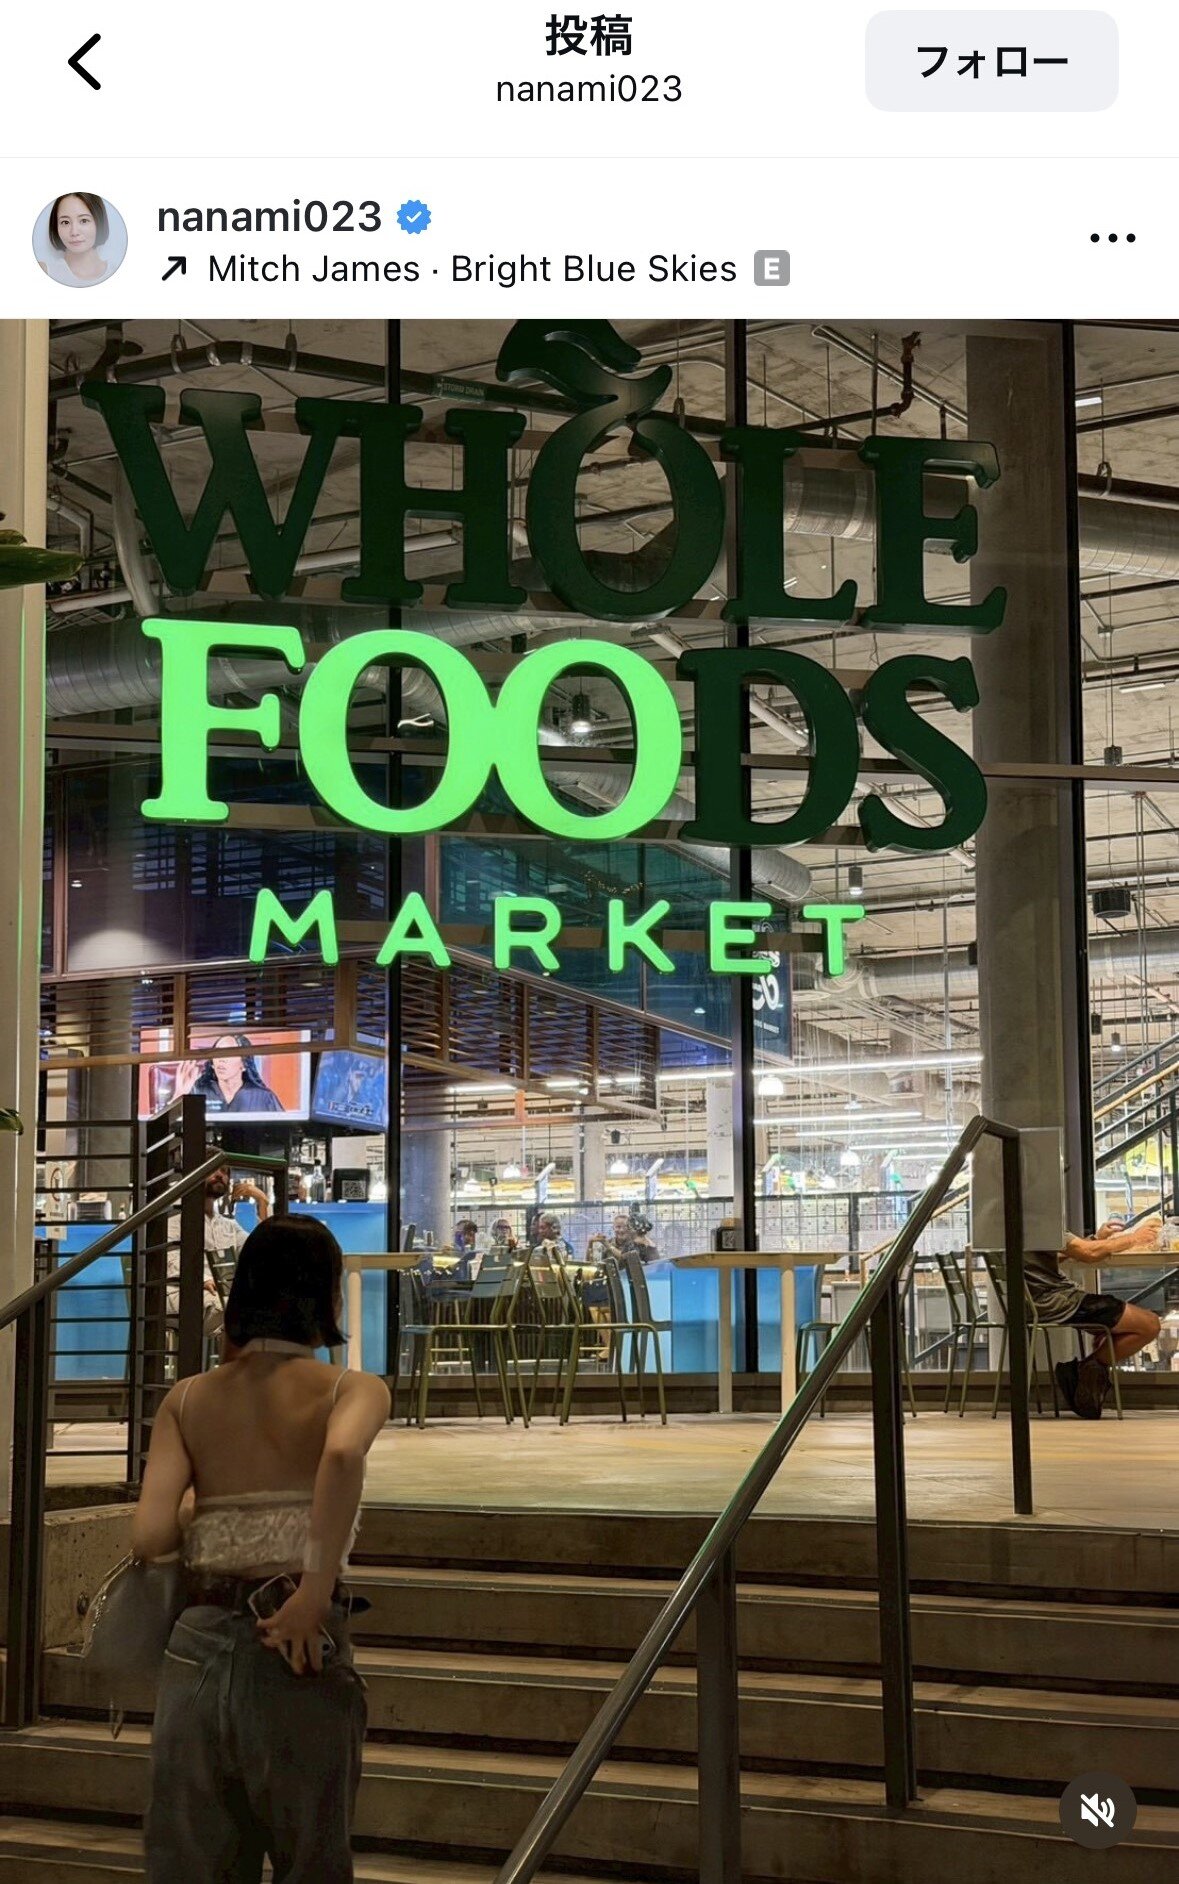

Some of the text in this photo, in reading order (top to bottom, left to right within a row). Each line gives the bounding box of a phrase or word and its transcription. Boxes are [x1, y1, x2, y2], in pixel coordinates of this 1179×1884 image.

[80, 322, 1007, 633] WHOLE
[141, 618, 988, 853] FOODS
[249, 888, 866, 978] MARKET
